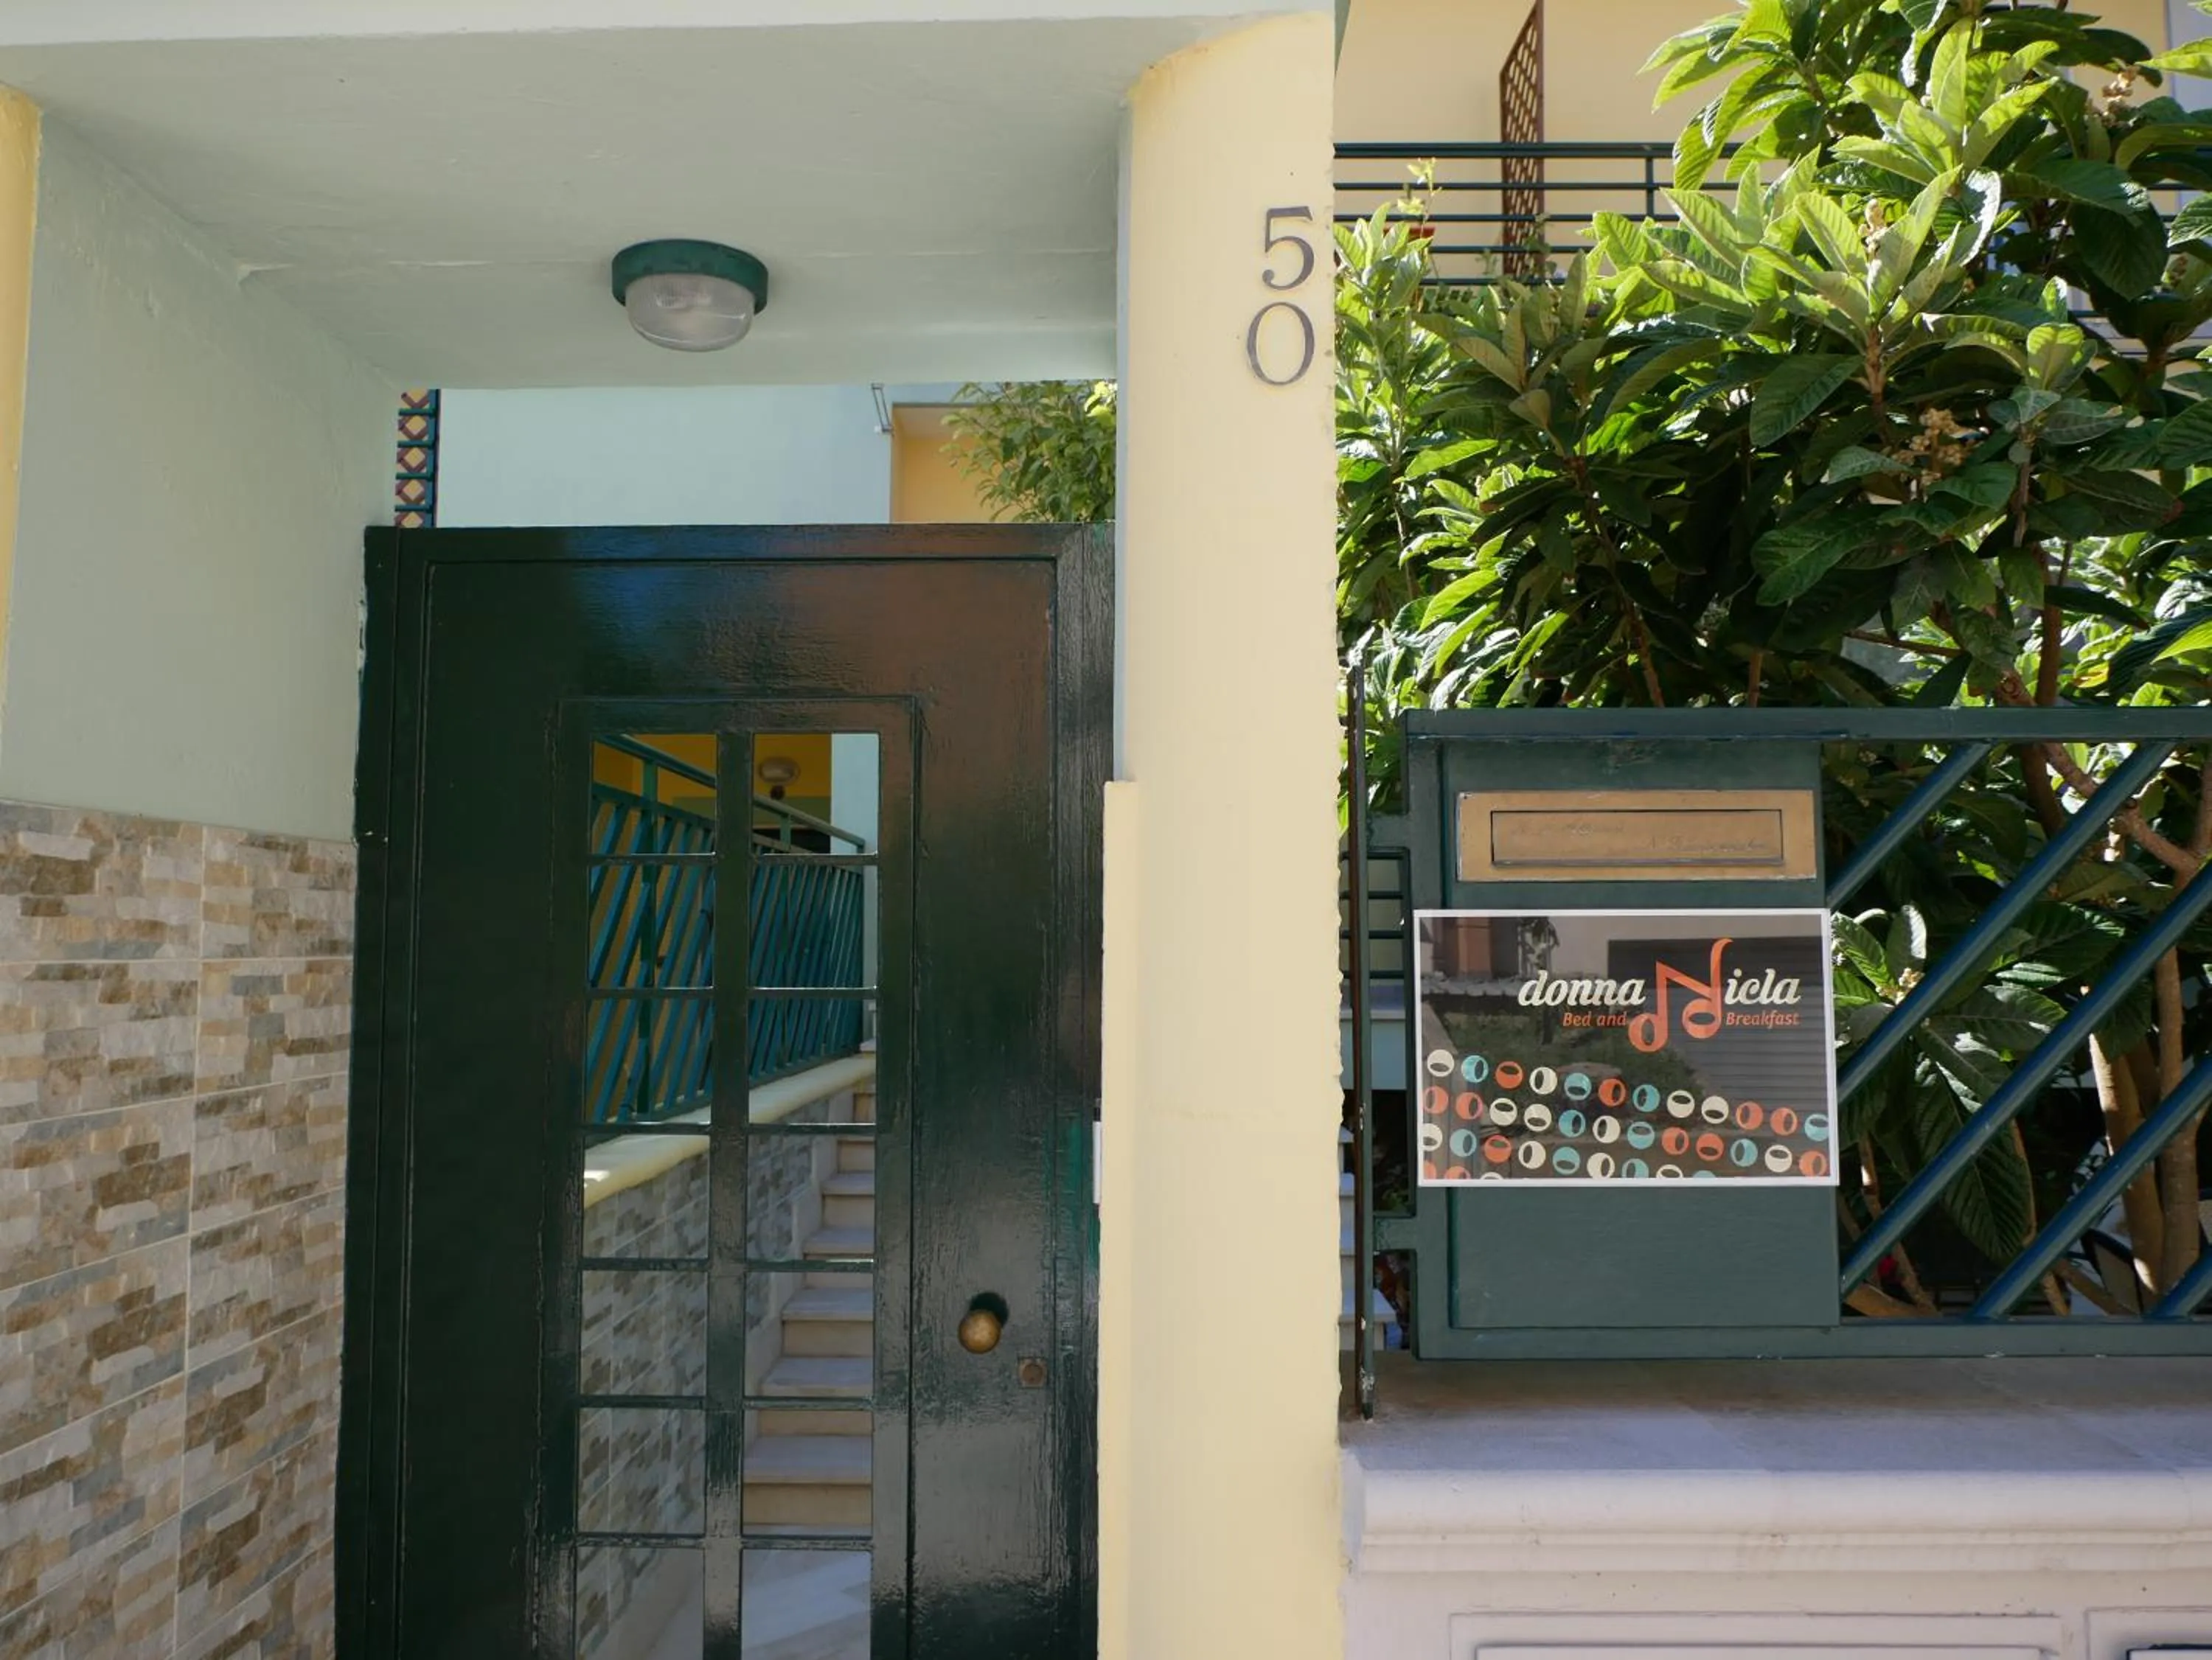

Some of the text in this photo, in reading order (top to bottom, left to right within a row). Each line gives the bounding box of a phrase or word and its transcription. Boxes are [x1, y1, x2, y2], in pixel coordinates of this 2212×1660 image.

[1518, 938, 1801, 1053] donna Nicla
[1562, 1009, 1801, 1030] Bed and Breakfast
